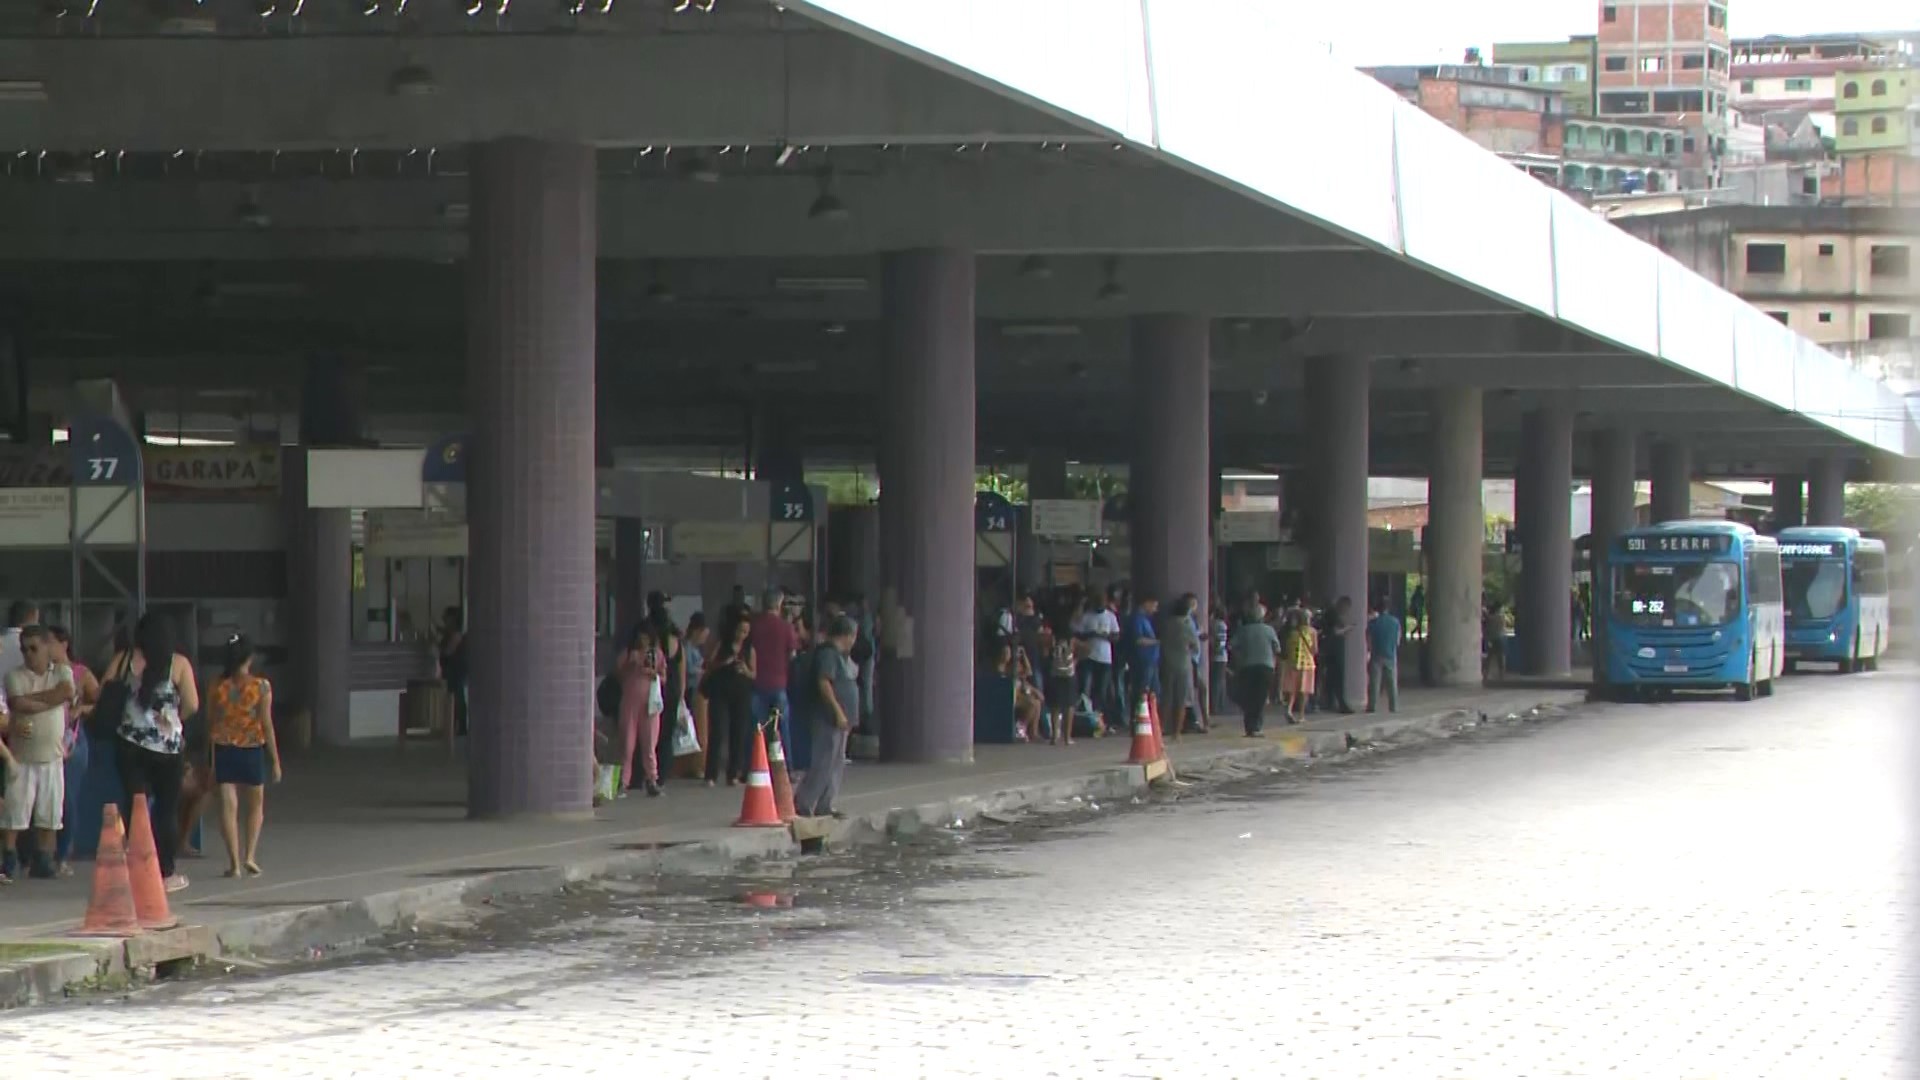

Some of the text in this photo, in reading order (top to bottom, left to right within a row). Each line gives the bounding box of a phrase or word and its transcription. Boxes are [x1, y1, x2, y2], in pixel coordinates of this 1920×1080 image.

[88, 457, 118, 480] 37
[157, 459, 256, 480] GARAPA
[783, 503, 804, 519] 35
[986, 516, 1006, 530] 34
[1660, 537, 1710, 551] SERRA
